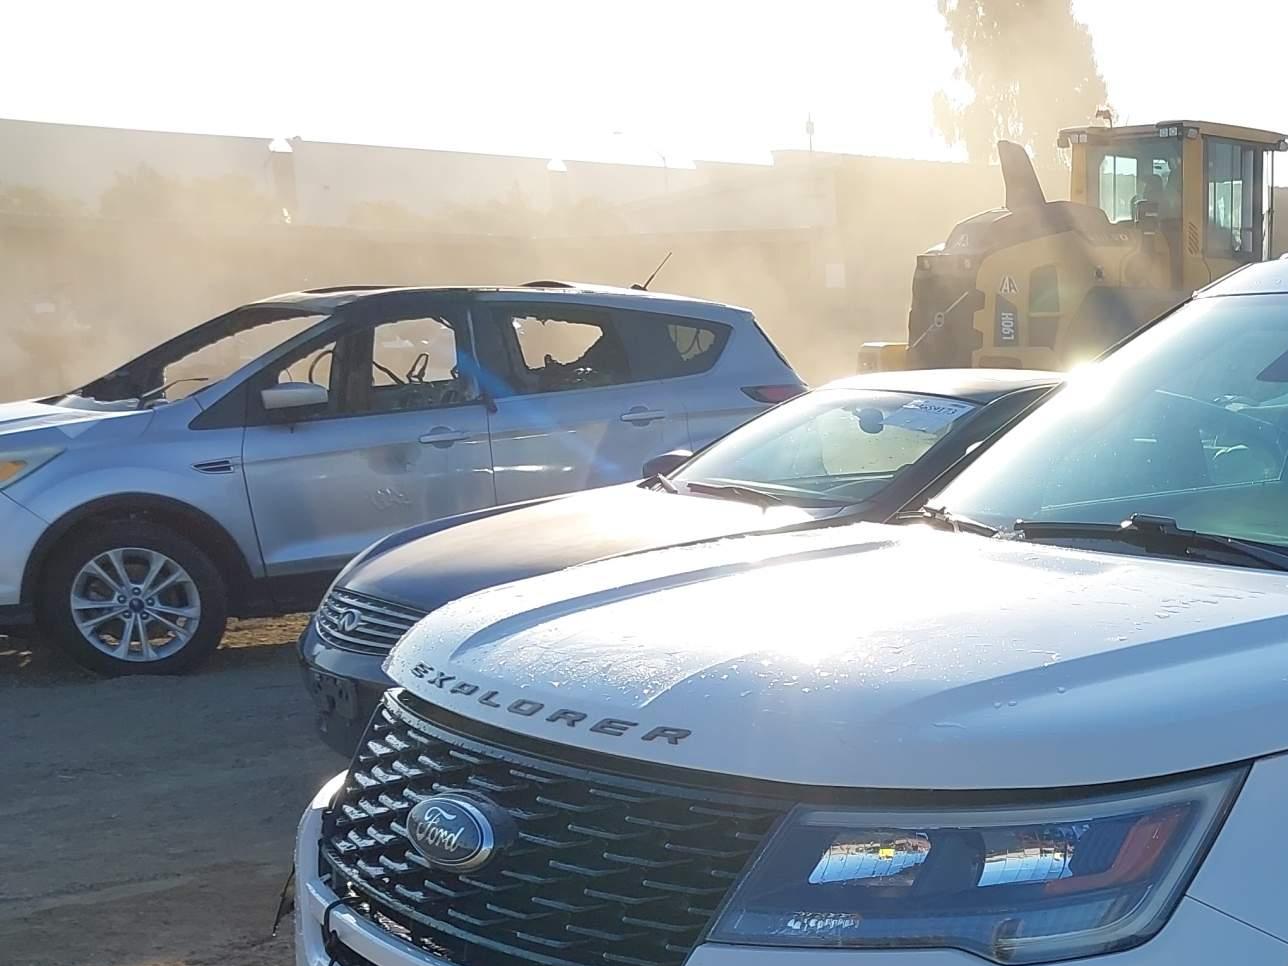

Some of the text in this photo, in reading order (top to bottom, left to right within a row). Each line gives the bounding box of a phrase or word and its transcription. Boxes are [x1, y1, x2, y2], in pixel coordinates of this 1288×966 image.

[1001, 312, 1015, 341] L90H
[411, 660, 693, 746] EXPLORER
[416, 806, 463, 852] Ford
